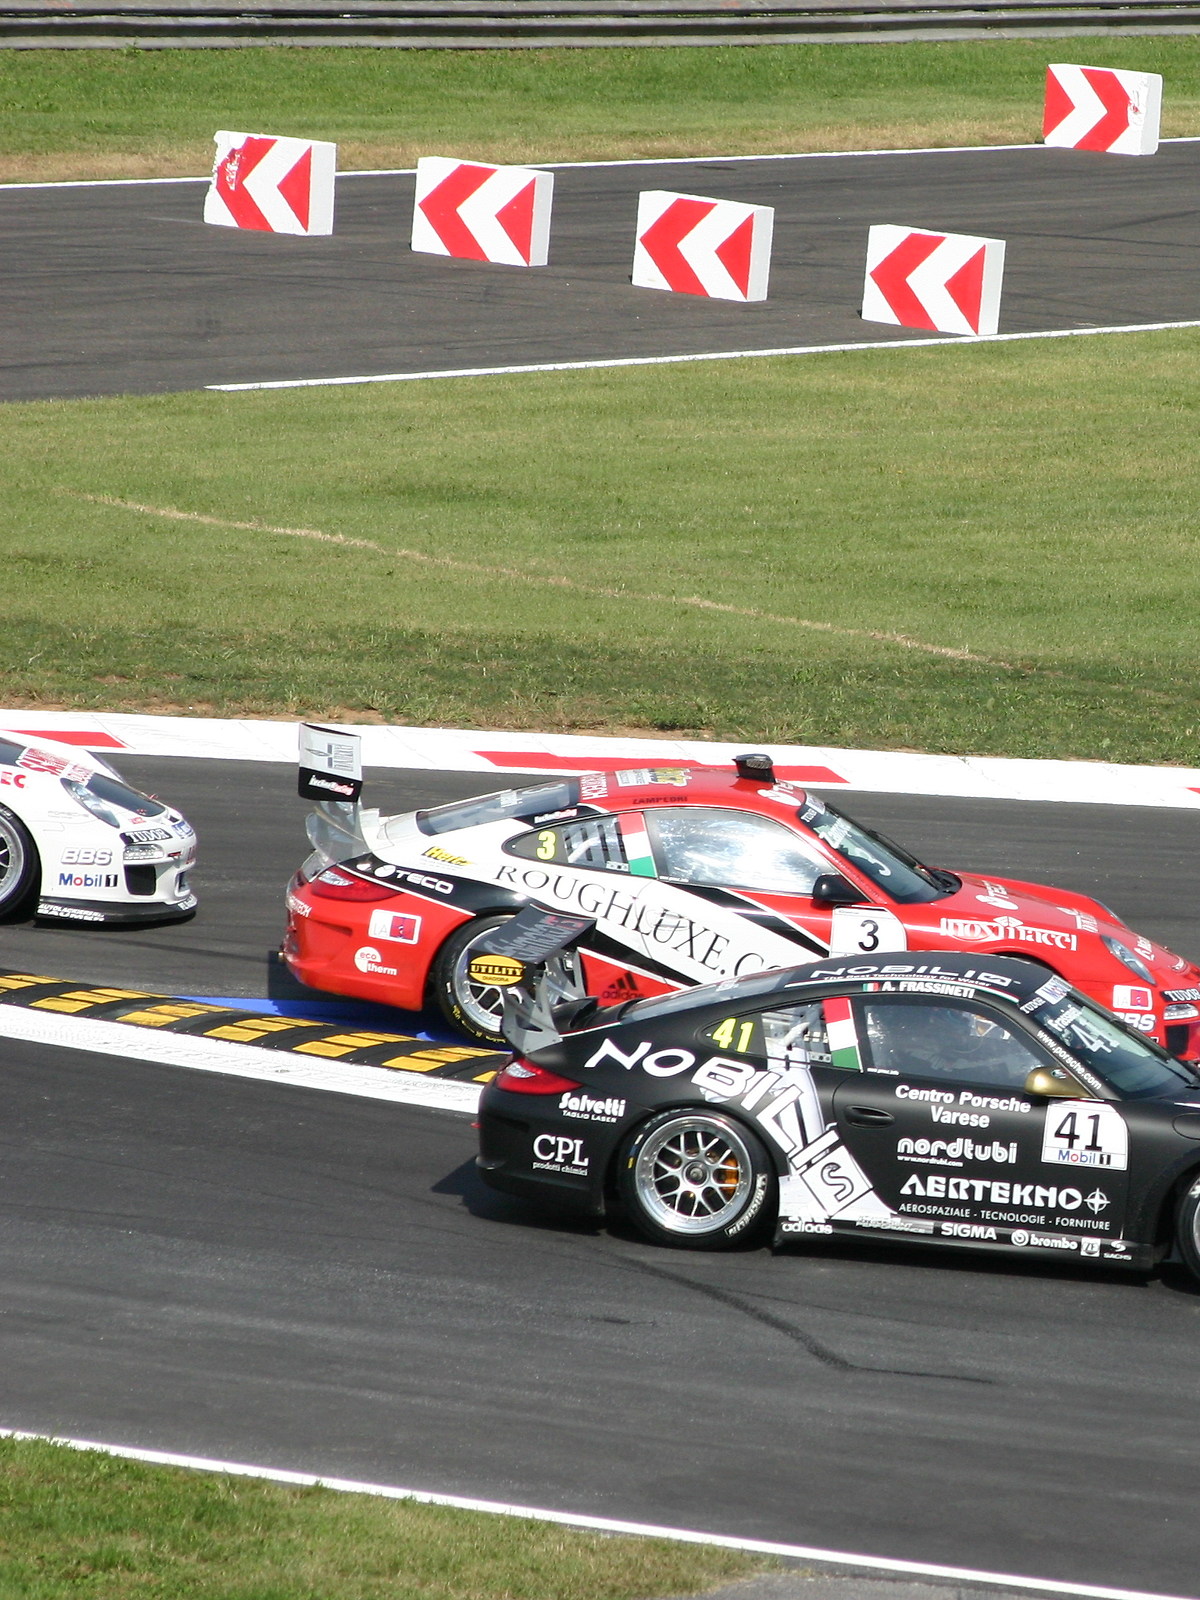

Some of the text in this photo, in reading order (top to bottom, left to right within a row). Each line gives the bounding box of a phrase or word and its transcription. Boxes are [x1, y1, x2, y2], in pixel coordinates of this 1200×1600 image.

[126, 829, 170, 843] TUDOR
[537, 831, 556, 859] 3
[60, 847, 113, 866] BBS
[58, 873, 118, 888] Mobil 1
[396, 870, 453, 894] TECO
[495, 865, 781, 978] ROUGHLUXE.C
[858, 920, 879, 951] 3
[360, 952, 377, 960] eco
[367, 962, 397, 976] therm
[470, 965, 523, 976] UTILITY
[810, 965, 1012, 986] NOBILIS
[882, 981, 975, 999] A. FRASSINETI
[712, 1017, 753, 1053] 41
[1036, 1030, 1102, 1090] www.porsche.com
[558, 1092, 627, 1118] Salvetti
[895, 1084, 1031, 1114] Centro Porsche
[563, 1110, 590, 1120] TAGLIO
[931, 1106, 990, 1128] Varese
[1054, 1112, 1103, 1150] 41
[533, 1133, 589, 1167] CPL
[897, 1137, 1018, 1164] nordtubi
[1058, 1150, 1096, 1164] Mobil
[532, 1161, 588, 1176] prodotti chimici
[899, 1203, 970, 1218] AEROSPAZIALE
[981, 1210, 1045, 1225] TECNOLOGIE
[1055, 1217, 1110, 1231] FORNITURE
[782, 1222, 833, 1234] adidas
[941, 1222, 997, 1240] SIGMA
[1030, 1234, 1077, 1250] brembo
[1103, 1253, 1132, 1261] SACHS
